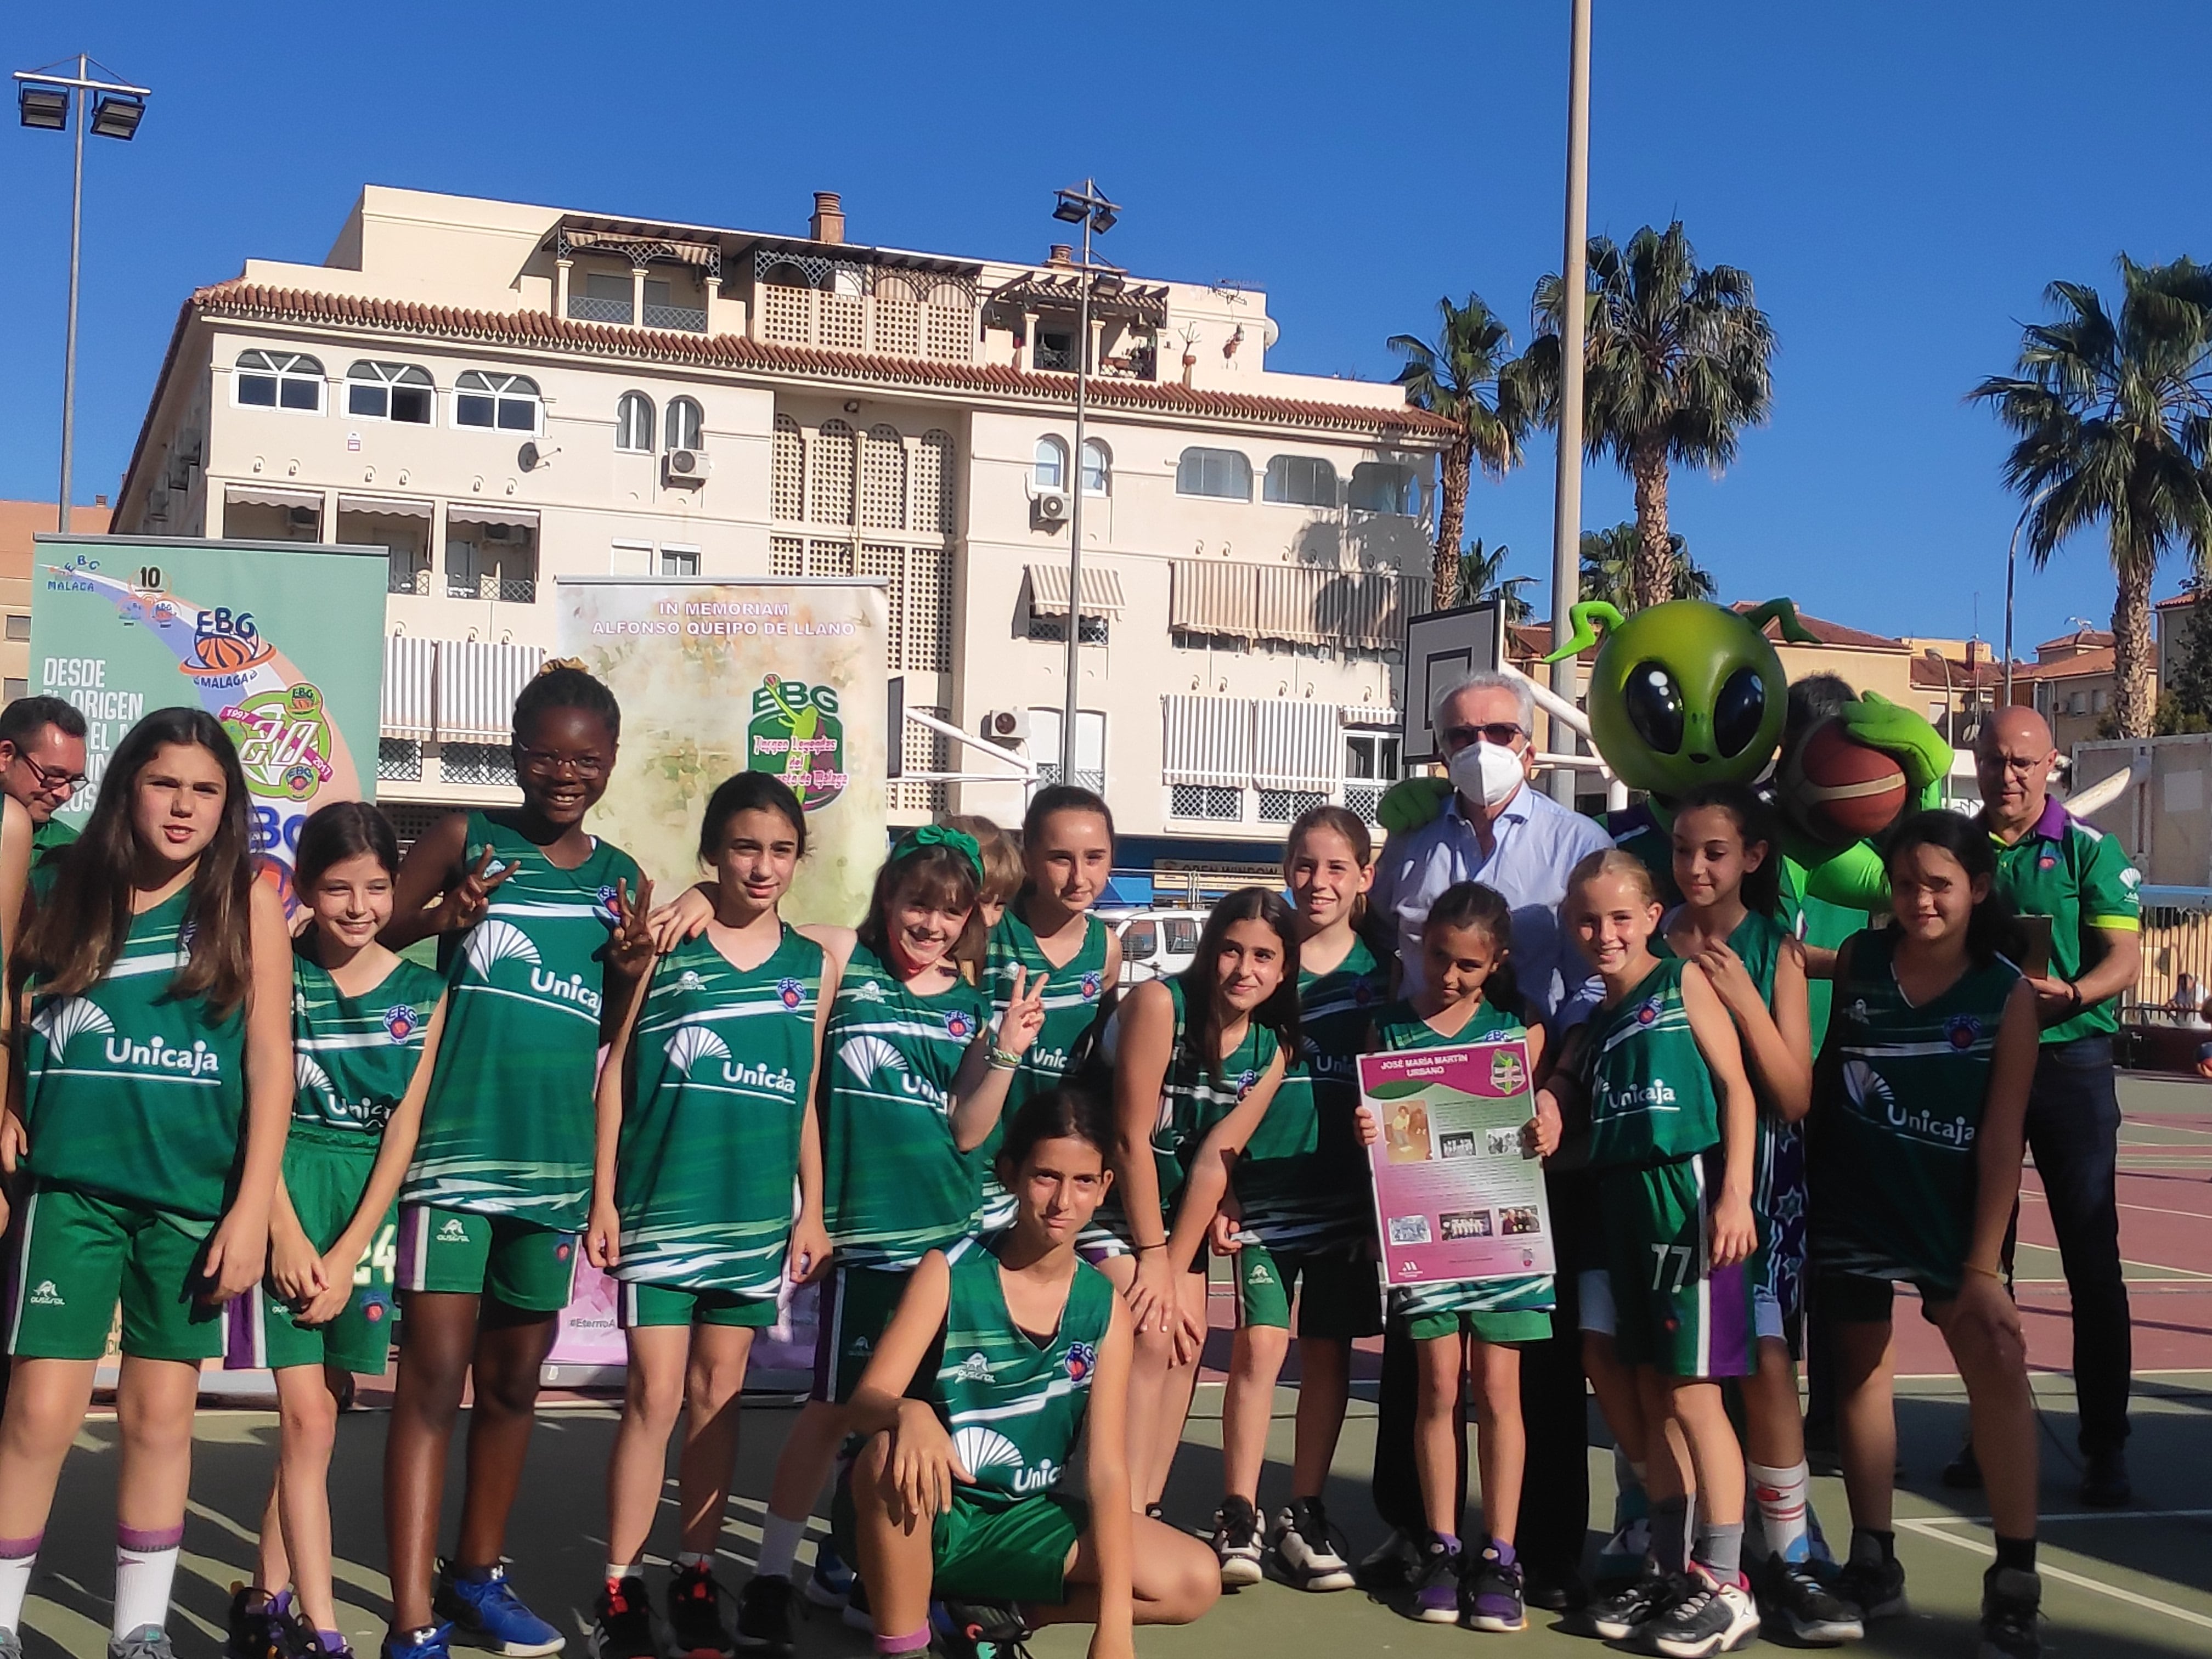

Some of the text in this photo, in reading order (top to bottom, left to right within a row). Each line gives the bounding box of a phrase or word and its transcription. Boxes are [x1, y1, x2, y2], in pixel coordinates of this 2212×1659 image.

[140, 567, 161, 588] 10
[196, 607, 255, 638] EBG
[659, 602, 788, 616] IN MEMORIAM
[592, 622, 855, 635] ALFONSO QUEIPO DE LLANO
[43, 658, 106, 687] DESDE
[70, 690, 144, 720] ORIGEN
[753, 682, 839, 714] EBG
[91, 721, 110, 751] EL
[239, 720, 322, 766] 20
[312, 756, 331, 775] 2017
[386, 1005, 417, 1022] EBG
[106, 1036, 219, 1076] Unicaja
[1608, 1079, 1677, 1109] Unicaja
[1887, 1103, 1975, 1145] Unicaja
